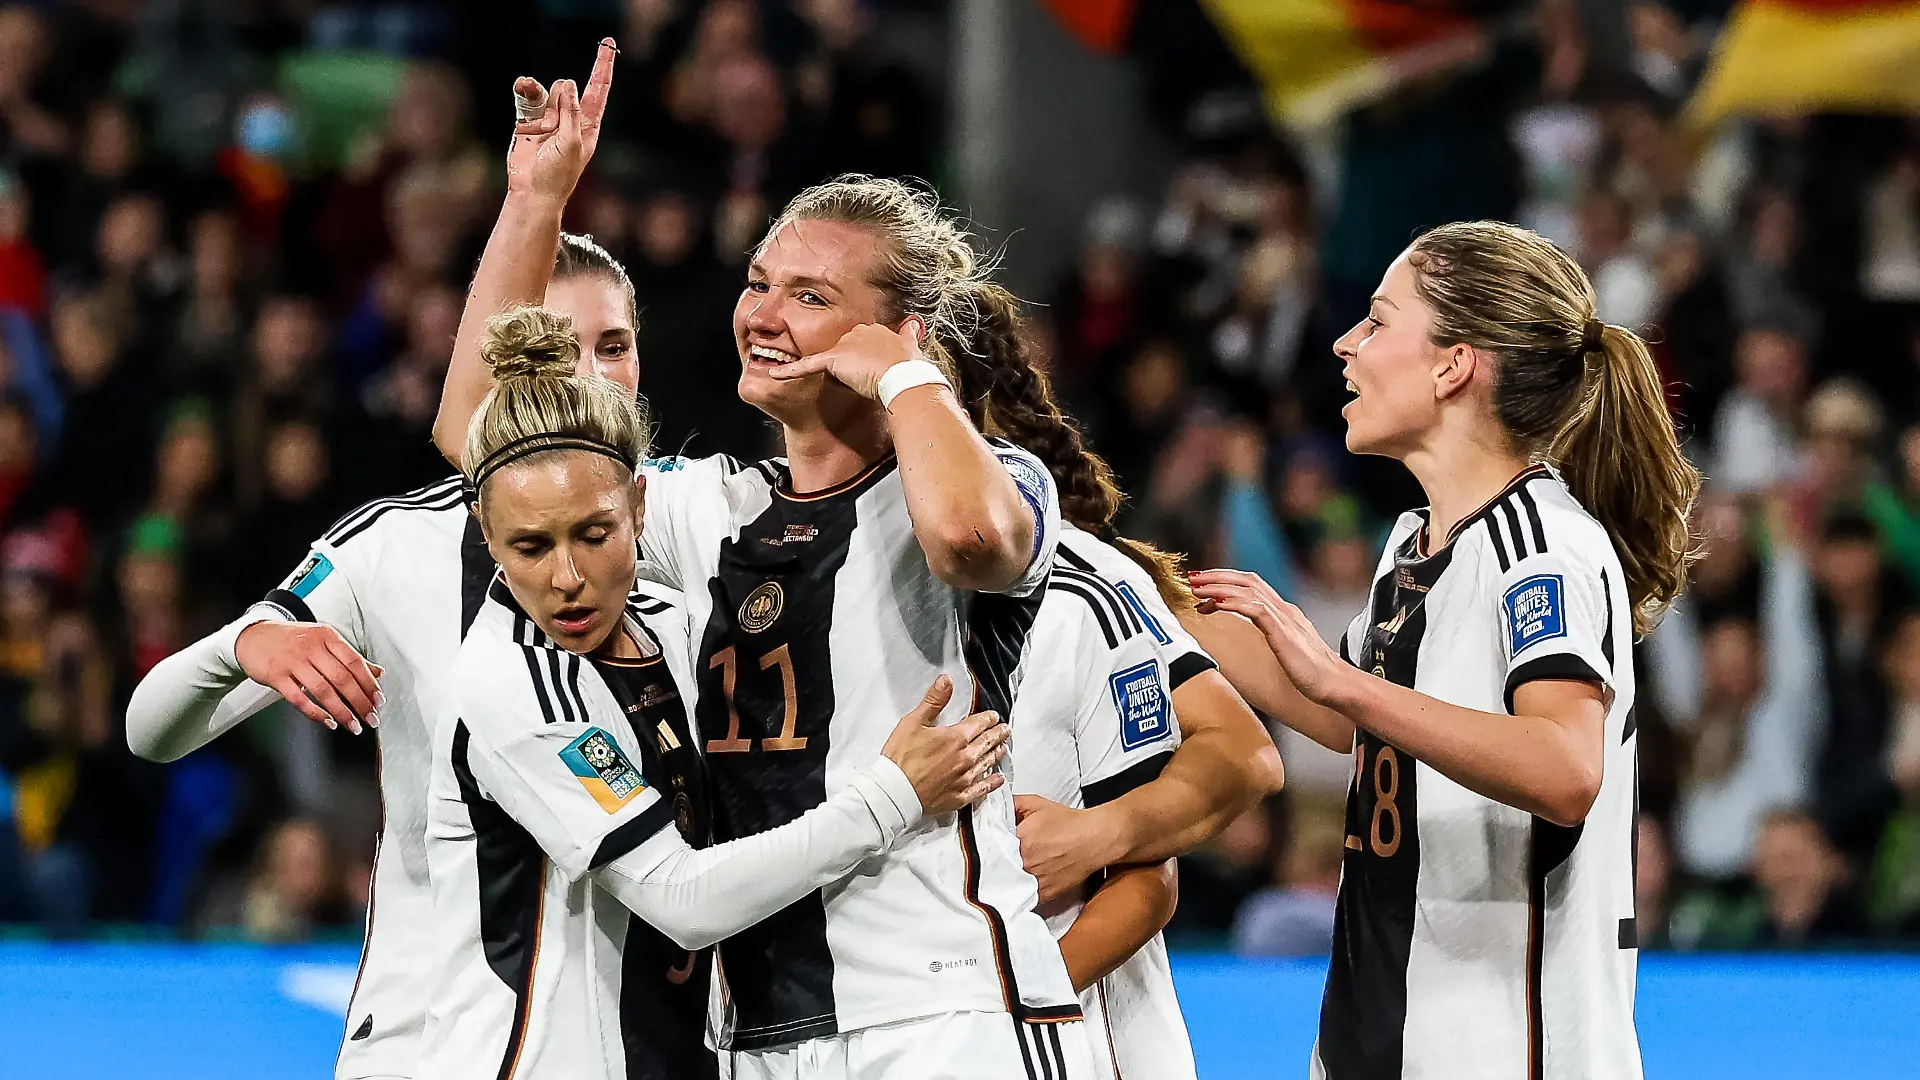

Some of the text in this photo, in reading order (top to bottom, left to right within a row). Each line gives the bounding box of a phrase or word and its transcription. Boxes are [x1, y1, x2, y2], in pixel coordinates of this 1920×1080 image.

[1515, 585, 1548, 607] FOOTBALL
[1515, 595, 1549, 620] UNITES
[1526, 606, 1552, 624] World
[1125, 674, 1157, 694] FOOTBALL
[707, 643, 808, 753] 11
[1129, 684, 1160, 708] UNITES
[1128, 698, 1161, 722] the World
[1141, 719, 1156, 729] FIFA
[601, 768, 611, 777] FIFA
[611, 771, 635, 791] AU 20
[616, 776, 640, 797] NZ 23
